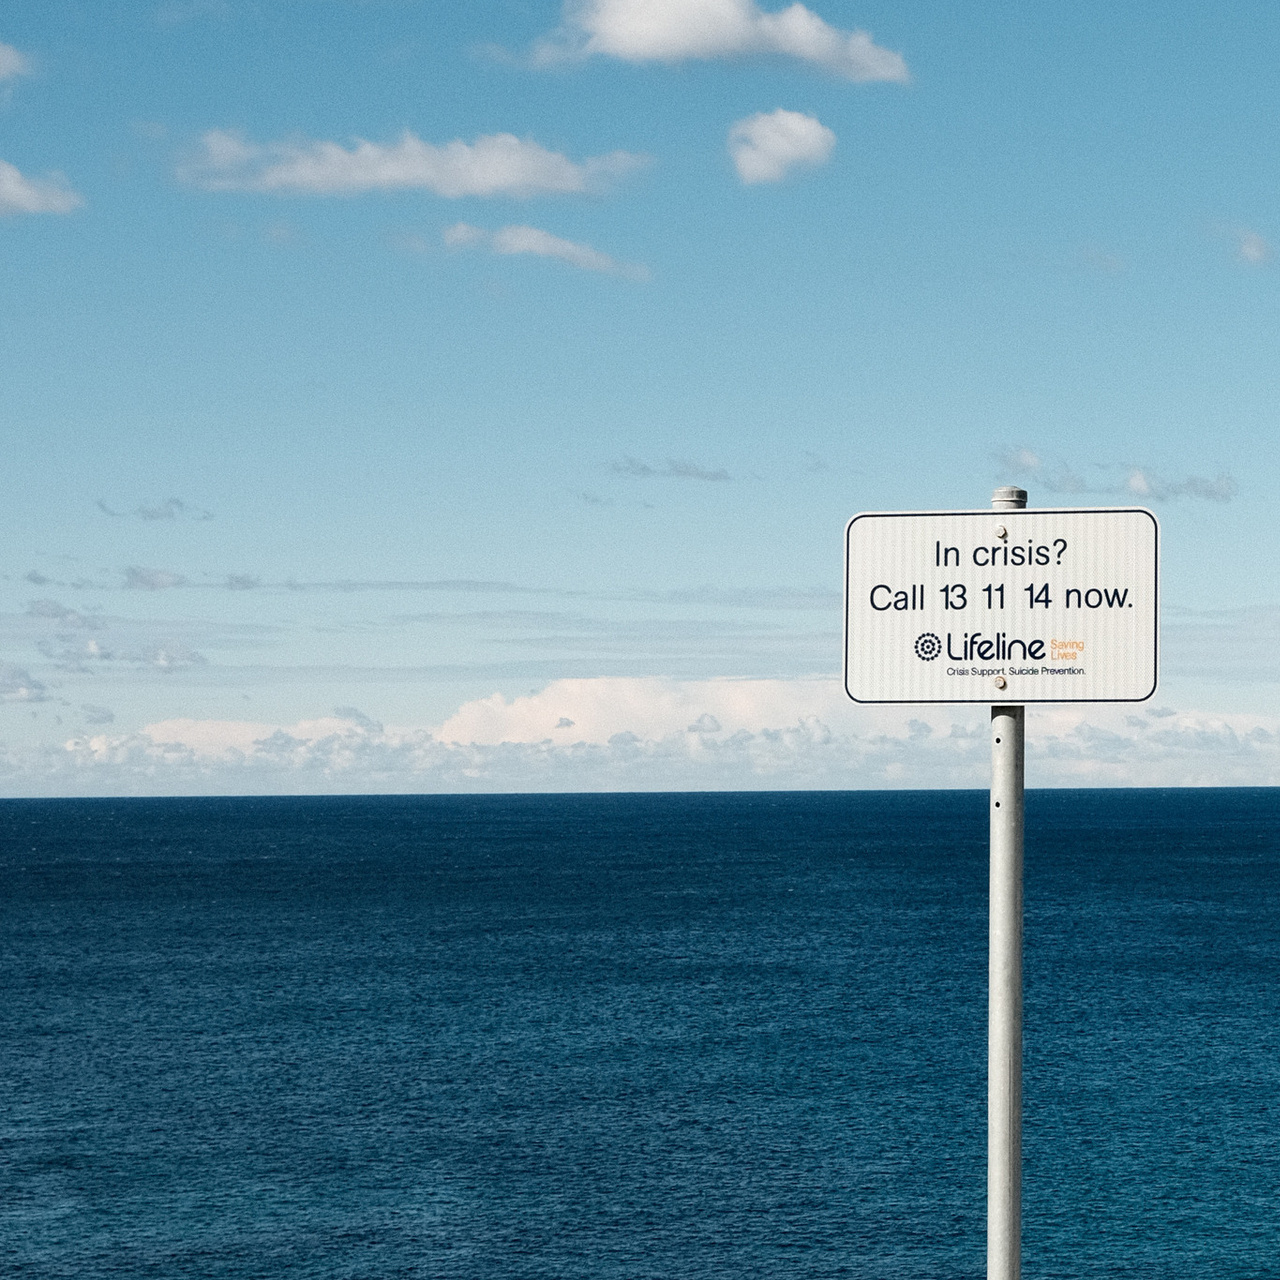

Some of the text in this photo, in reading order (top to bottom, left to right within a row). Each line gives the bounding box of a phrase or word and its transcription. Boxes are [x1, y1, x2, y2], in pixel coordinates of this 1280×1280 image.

[935, 538, 1068, 567] In crisis?
[869, 582, 1133, 611] Call 13 11 14 now.
[947, 632, 1046, 660] Lifeline
[1050, 639, 1085, 651] Saving
[1050, 650, 1077, 660] Lives
[946, 667, 1086, 677] Crisis Support. Suicide Prevention.
